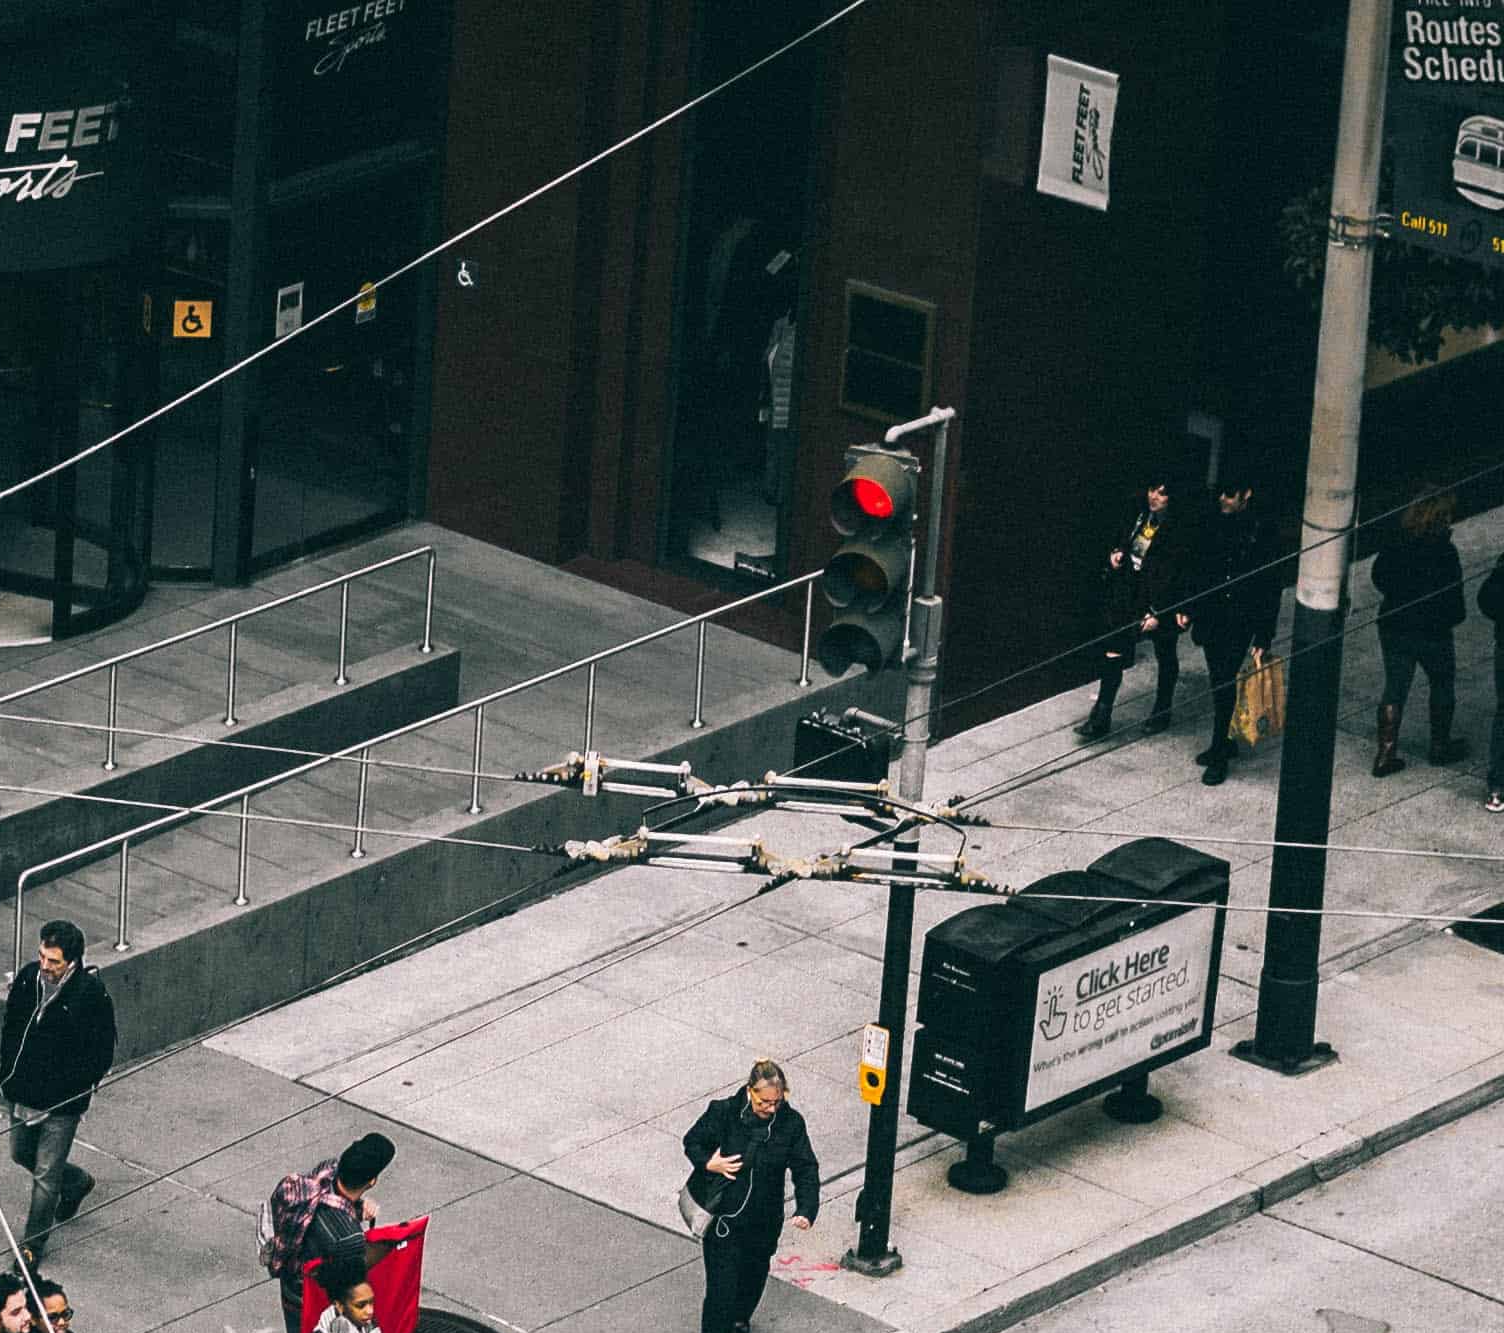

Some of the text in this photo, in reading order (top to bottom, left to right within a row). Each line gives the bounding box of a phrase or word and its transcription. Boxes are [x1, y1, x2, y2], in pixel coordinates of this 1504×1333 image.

[305, 6, 360, 41] FLEET
[1405, 10, 1501, 47] Routes
[5, 103, 119, 152] FEET
[1072, 83, 1091, 185] FLEET FEET
[1401, 211, 1448, 237] Call 511
[1076, 943, 1171, 1000] Click Here
[1073, 960, 1191, 1032] to get started.
[1033, 1055, 1062, 1074] What's
